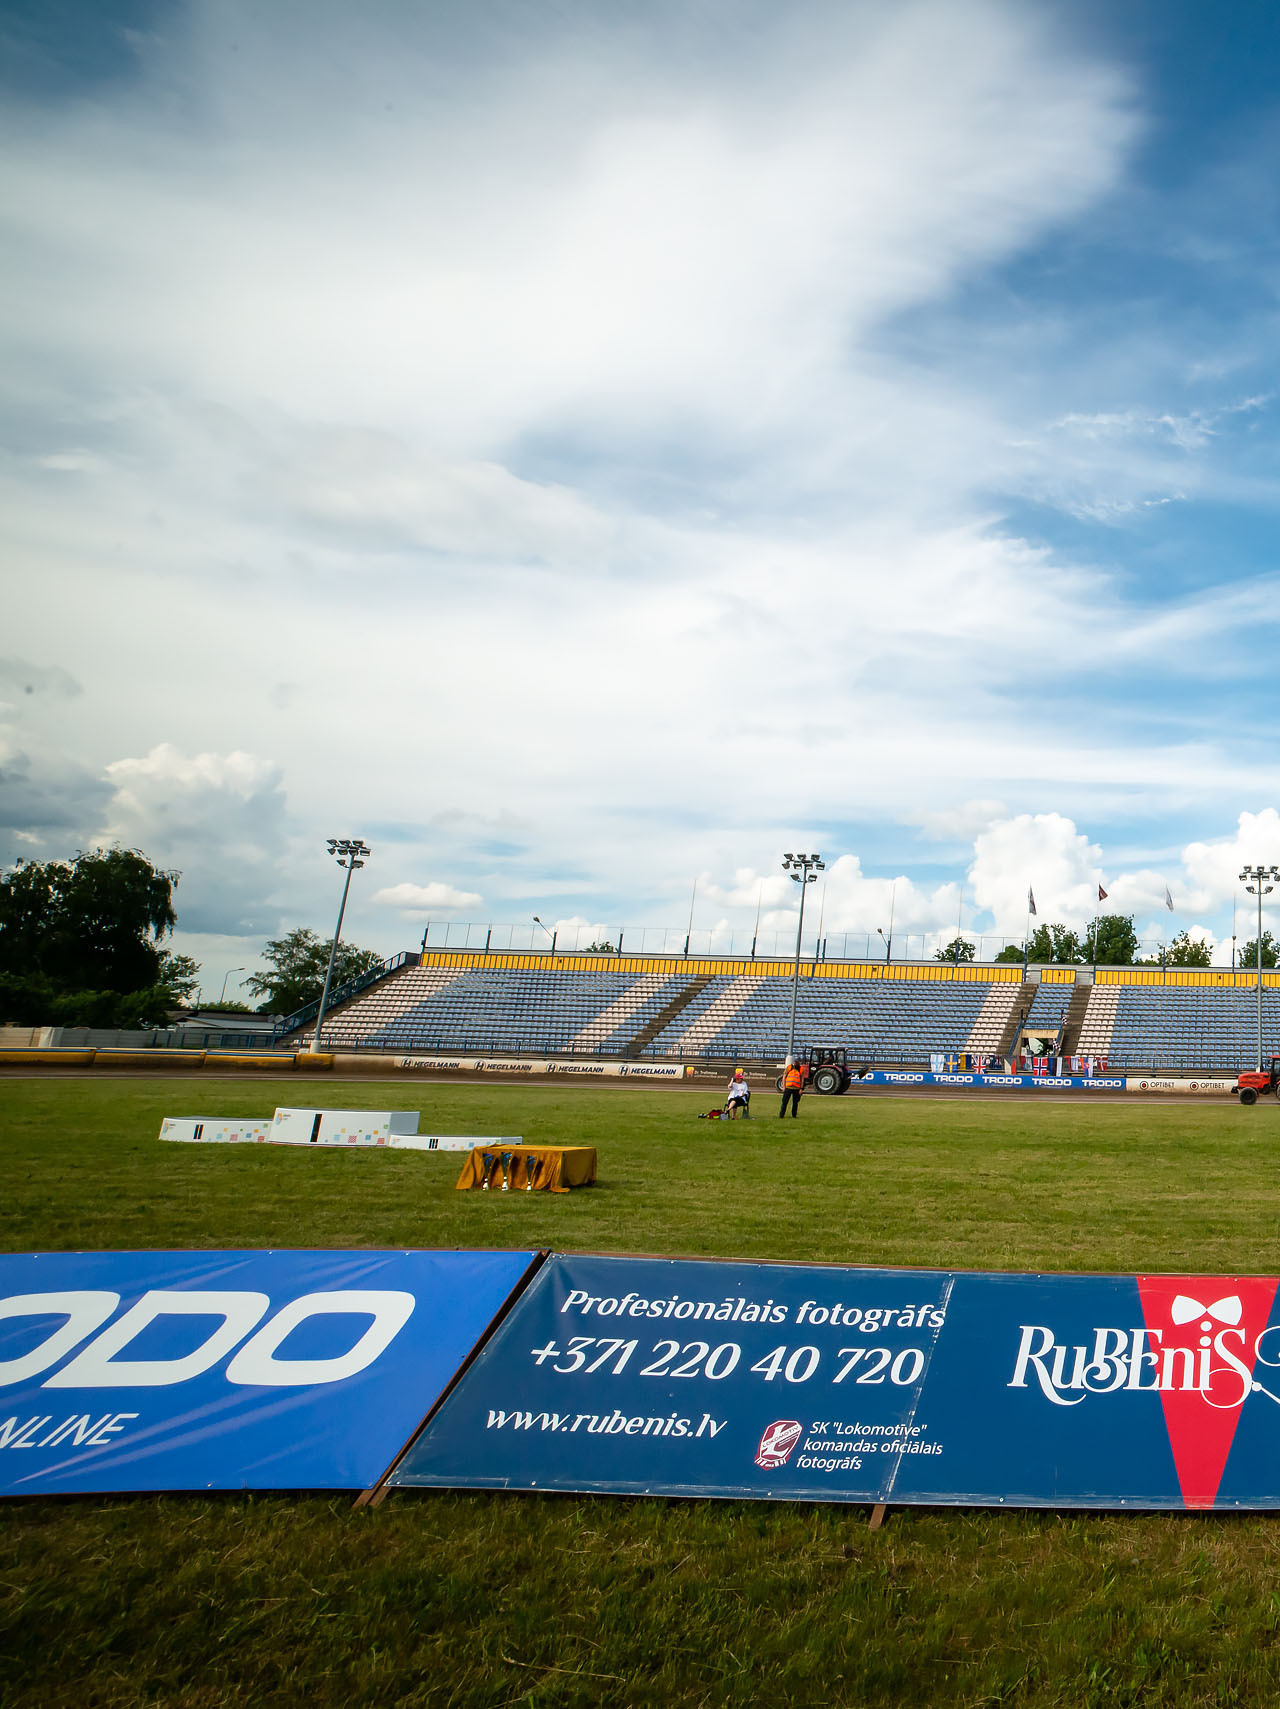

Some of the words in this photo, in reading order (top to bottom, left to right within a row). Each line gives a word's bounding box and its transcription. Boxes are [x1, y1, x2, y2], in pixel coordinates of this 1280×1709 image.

[413, 1061, 460, 1069] HEGELMANN
[487, 1063, 532, 1071] HEGELMANN
[631, 1067, 676, 1075] HEGELMANN
[884, 1073, 924, 1081] TRODO
[933, 1074, 973, 1083] TRODO
[982, 1076, 1022, 1084] TRODO
[1032, 1077, 1072, 1086] TRODO
[1081, 1079, 1122, 1087] TRODO
[560, 1290, 786, 1324] Profesionālais
[796, 1300, 946, 1332] fotogrāfs
[529, 1336, 639, 1375] +371
[640, 1340, 741, 1380] 220
[751, 1346, 820, 1383] 40
[831, 1348, 925, 1386] 720
[484, 1409, 728, 1439] www.rubenis.lv
[809, 1421, 830, 1434] SK
[832, 1421, 927, 1437] "Lokomotīve"
[803, 1437, 877, 1453] komandas
[880, 1439, 943, 1455] oficiālais
[796, 1454, 862, 1472] fotogrāfs
